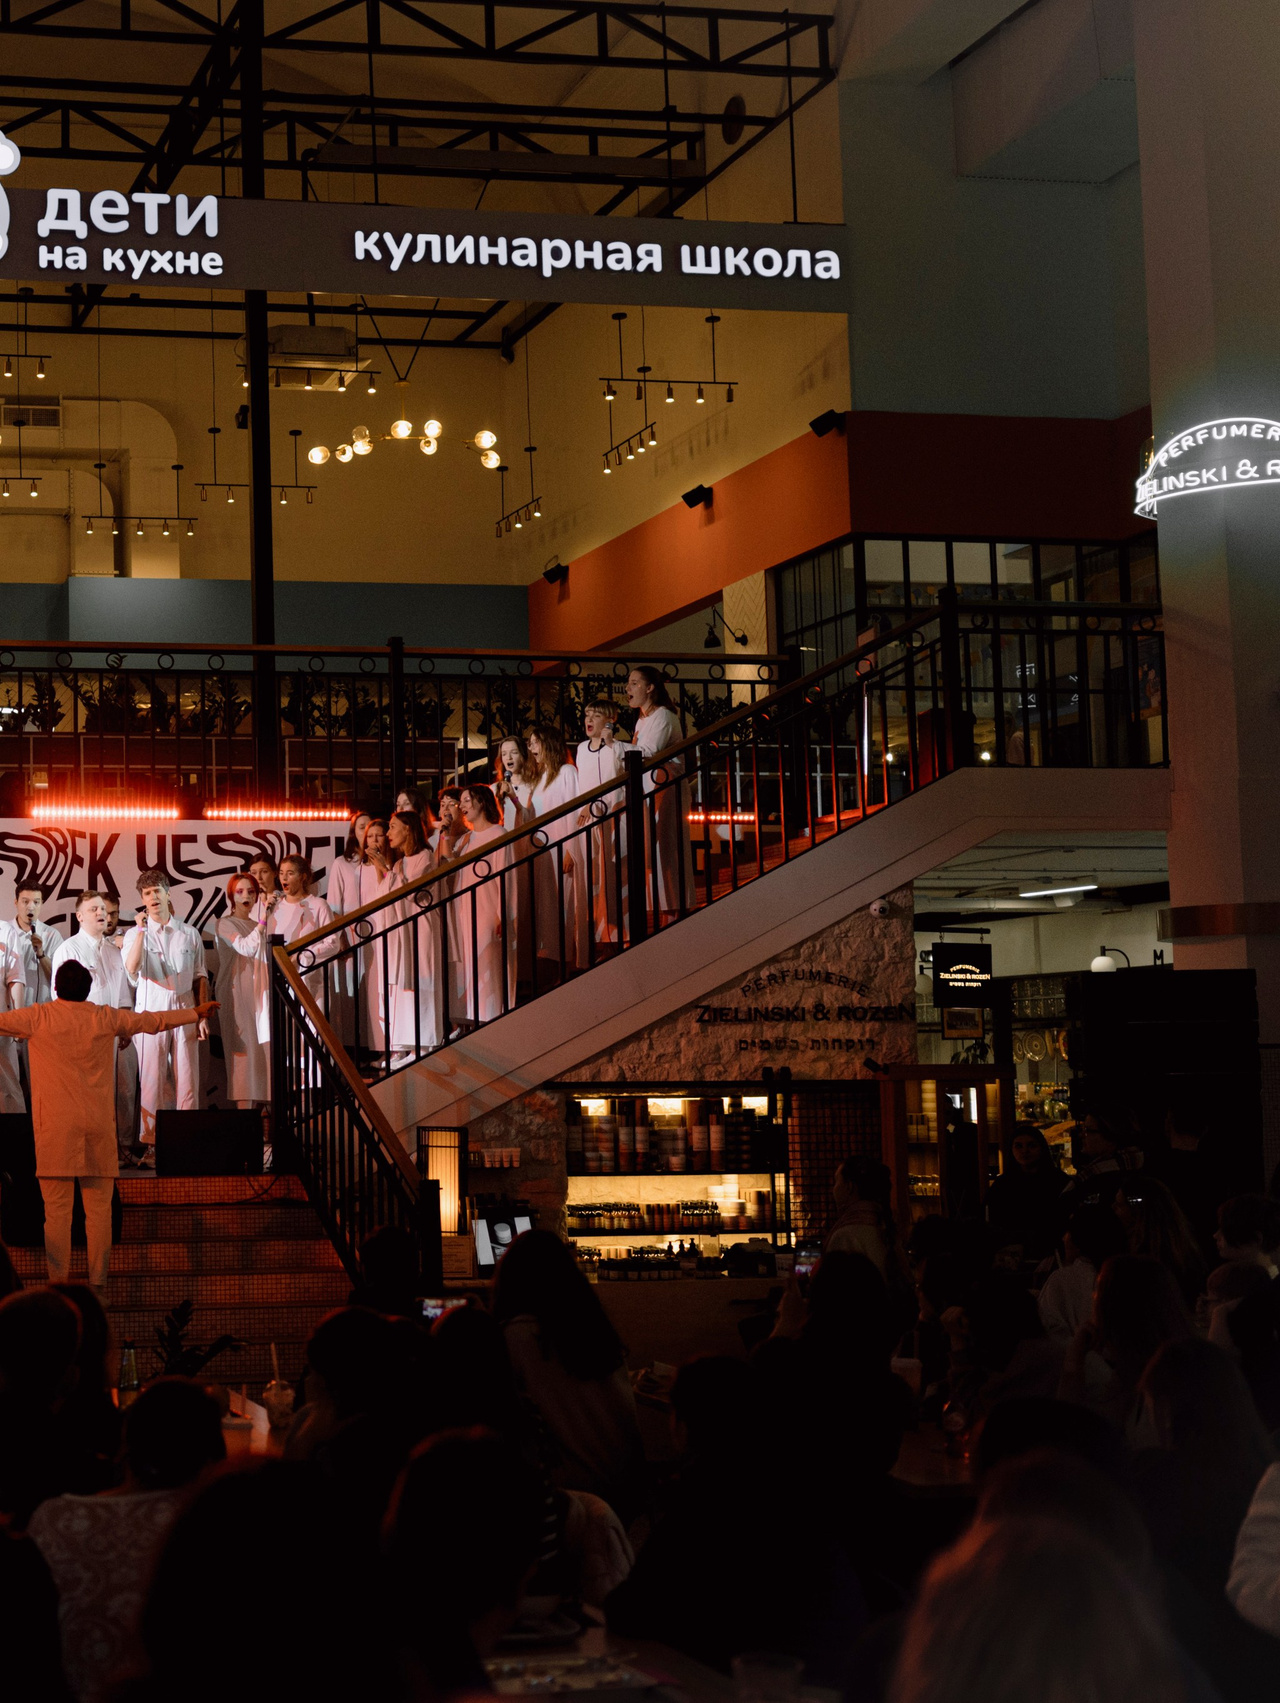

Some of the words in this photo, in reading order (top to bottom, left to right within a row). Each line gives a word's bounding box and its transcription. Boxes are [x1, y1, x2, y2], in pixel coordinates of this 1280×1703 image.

[38, 189, 219, 240] дети
[39, 247, 88, 271] на
[104, 248, 224, 281] кухне
[355, 231, 663, 279] кулинарная
[682, 245, 841, 280] школа
[1235, 459, 1260, 479] &
[740, 968, 870, 998] PERFUMERIE
[695, 1004, 806, 1023] ZIELINSKI
[813, 1003, 831, 1021] &
[837, 1003, 916, 1021] ROZEN
